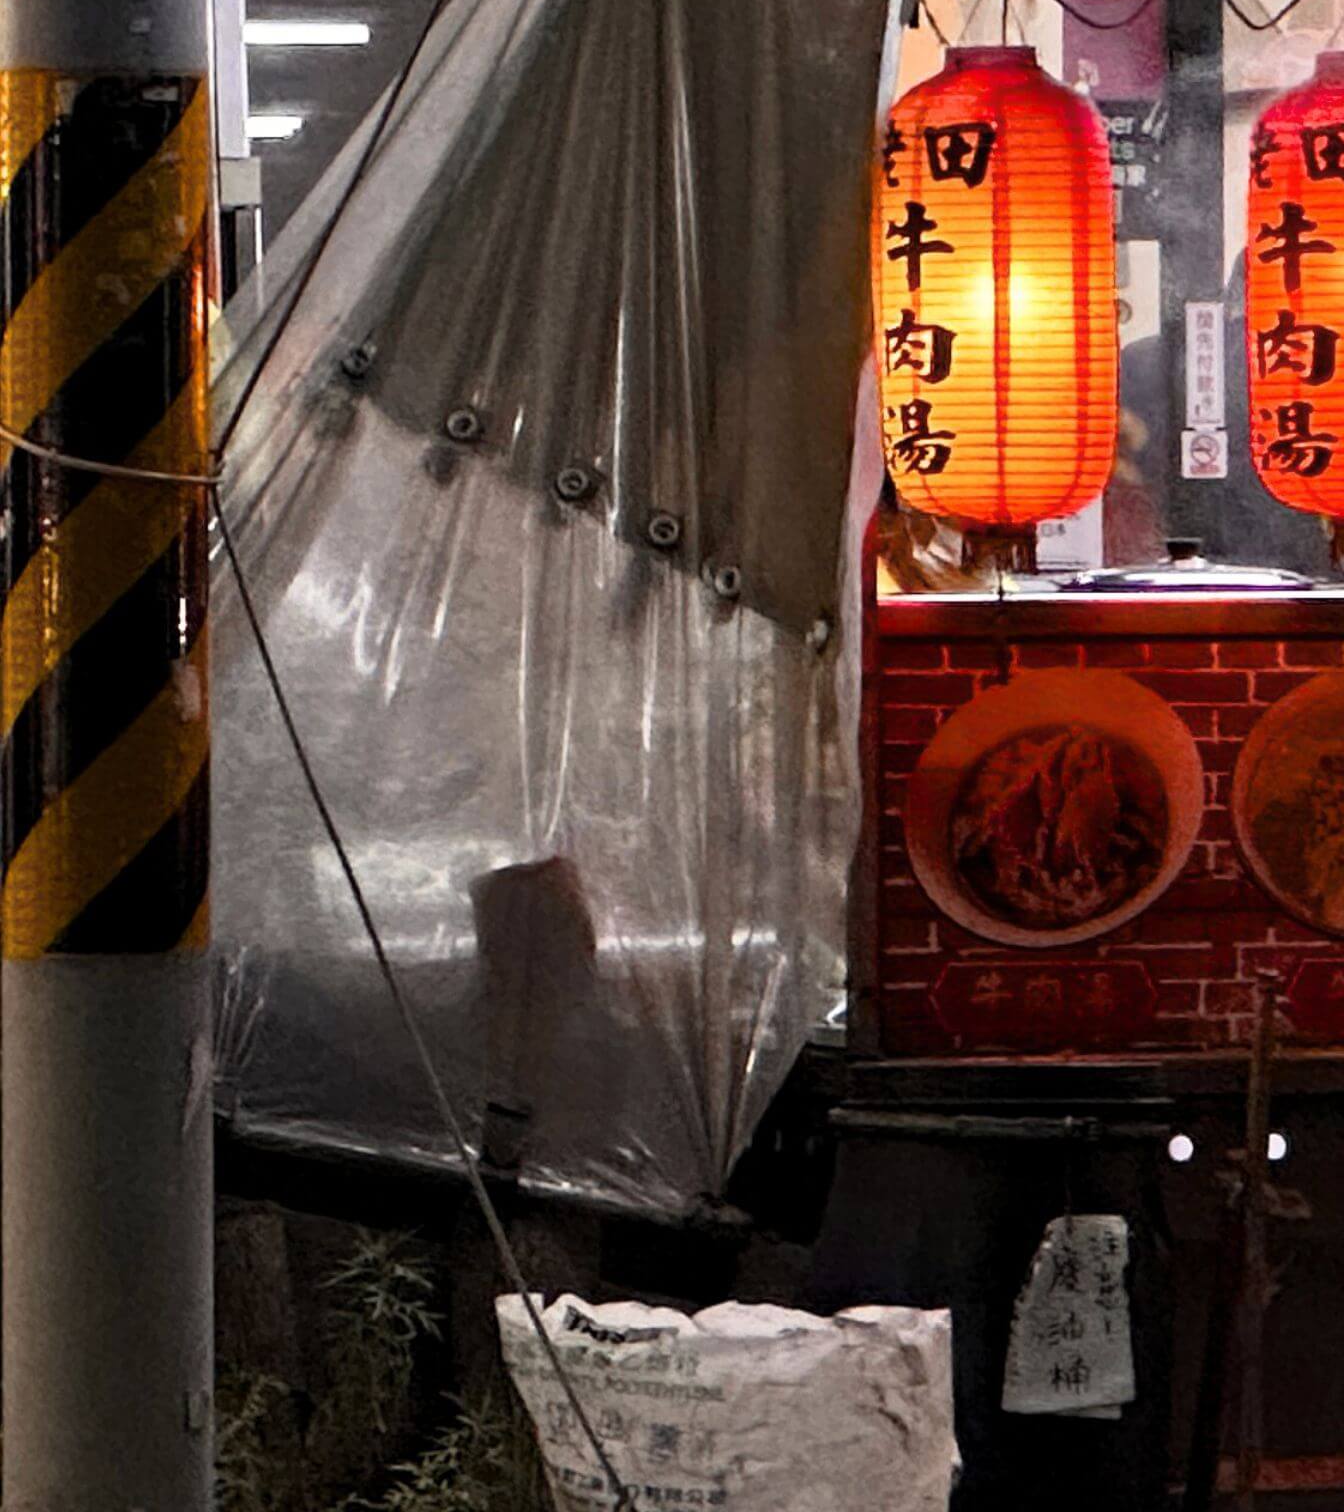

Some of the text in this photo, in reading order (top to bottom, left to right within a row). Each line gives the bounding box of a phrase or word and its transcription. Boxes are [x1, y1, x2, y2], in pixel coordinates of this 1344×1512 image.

[884, 200, 956, 476] 牛肉湯
[1256, 201, 1340, 477] 牛肉湯
